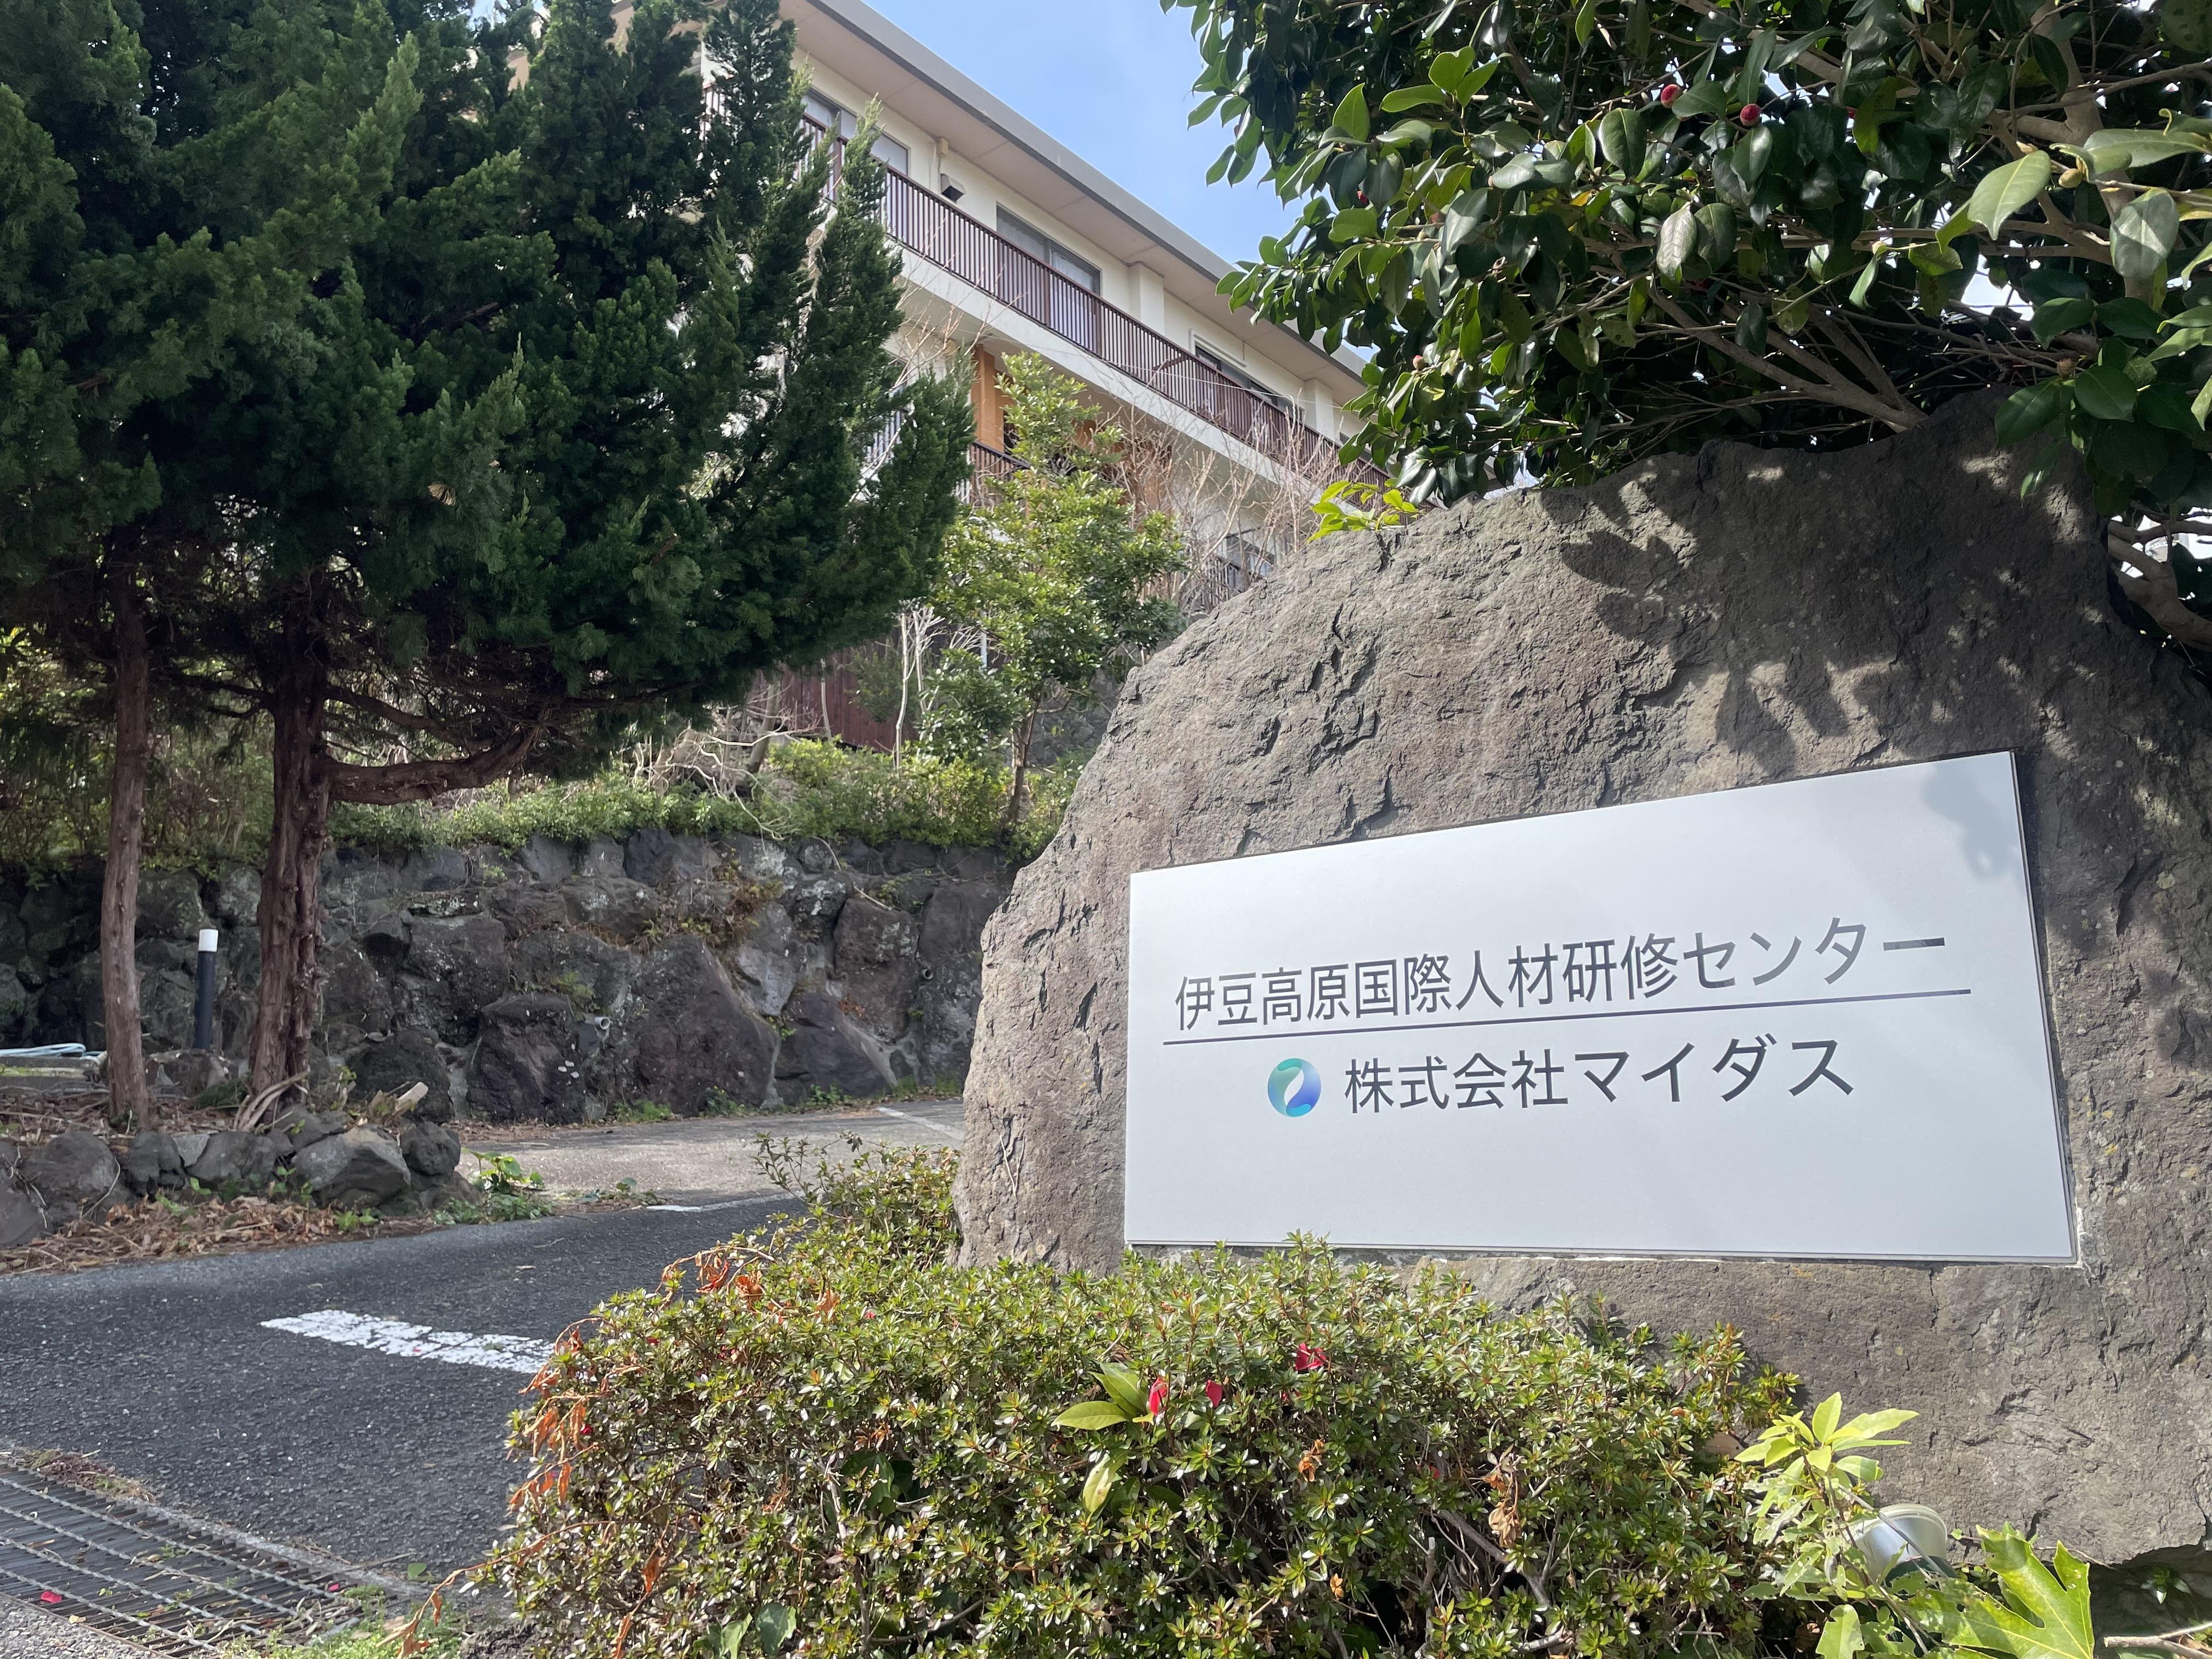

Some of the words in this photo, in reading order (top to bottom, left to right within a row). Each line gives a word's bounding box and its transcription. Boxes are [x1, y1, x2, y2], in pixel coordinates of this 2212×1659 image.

[1175, 917, 1946, 1031] 伊豆高原国際人材研修センター
[1344, 1033, 1854, 1114] 株式会社マイダス
